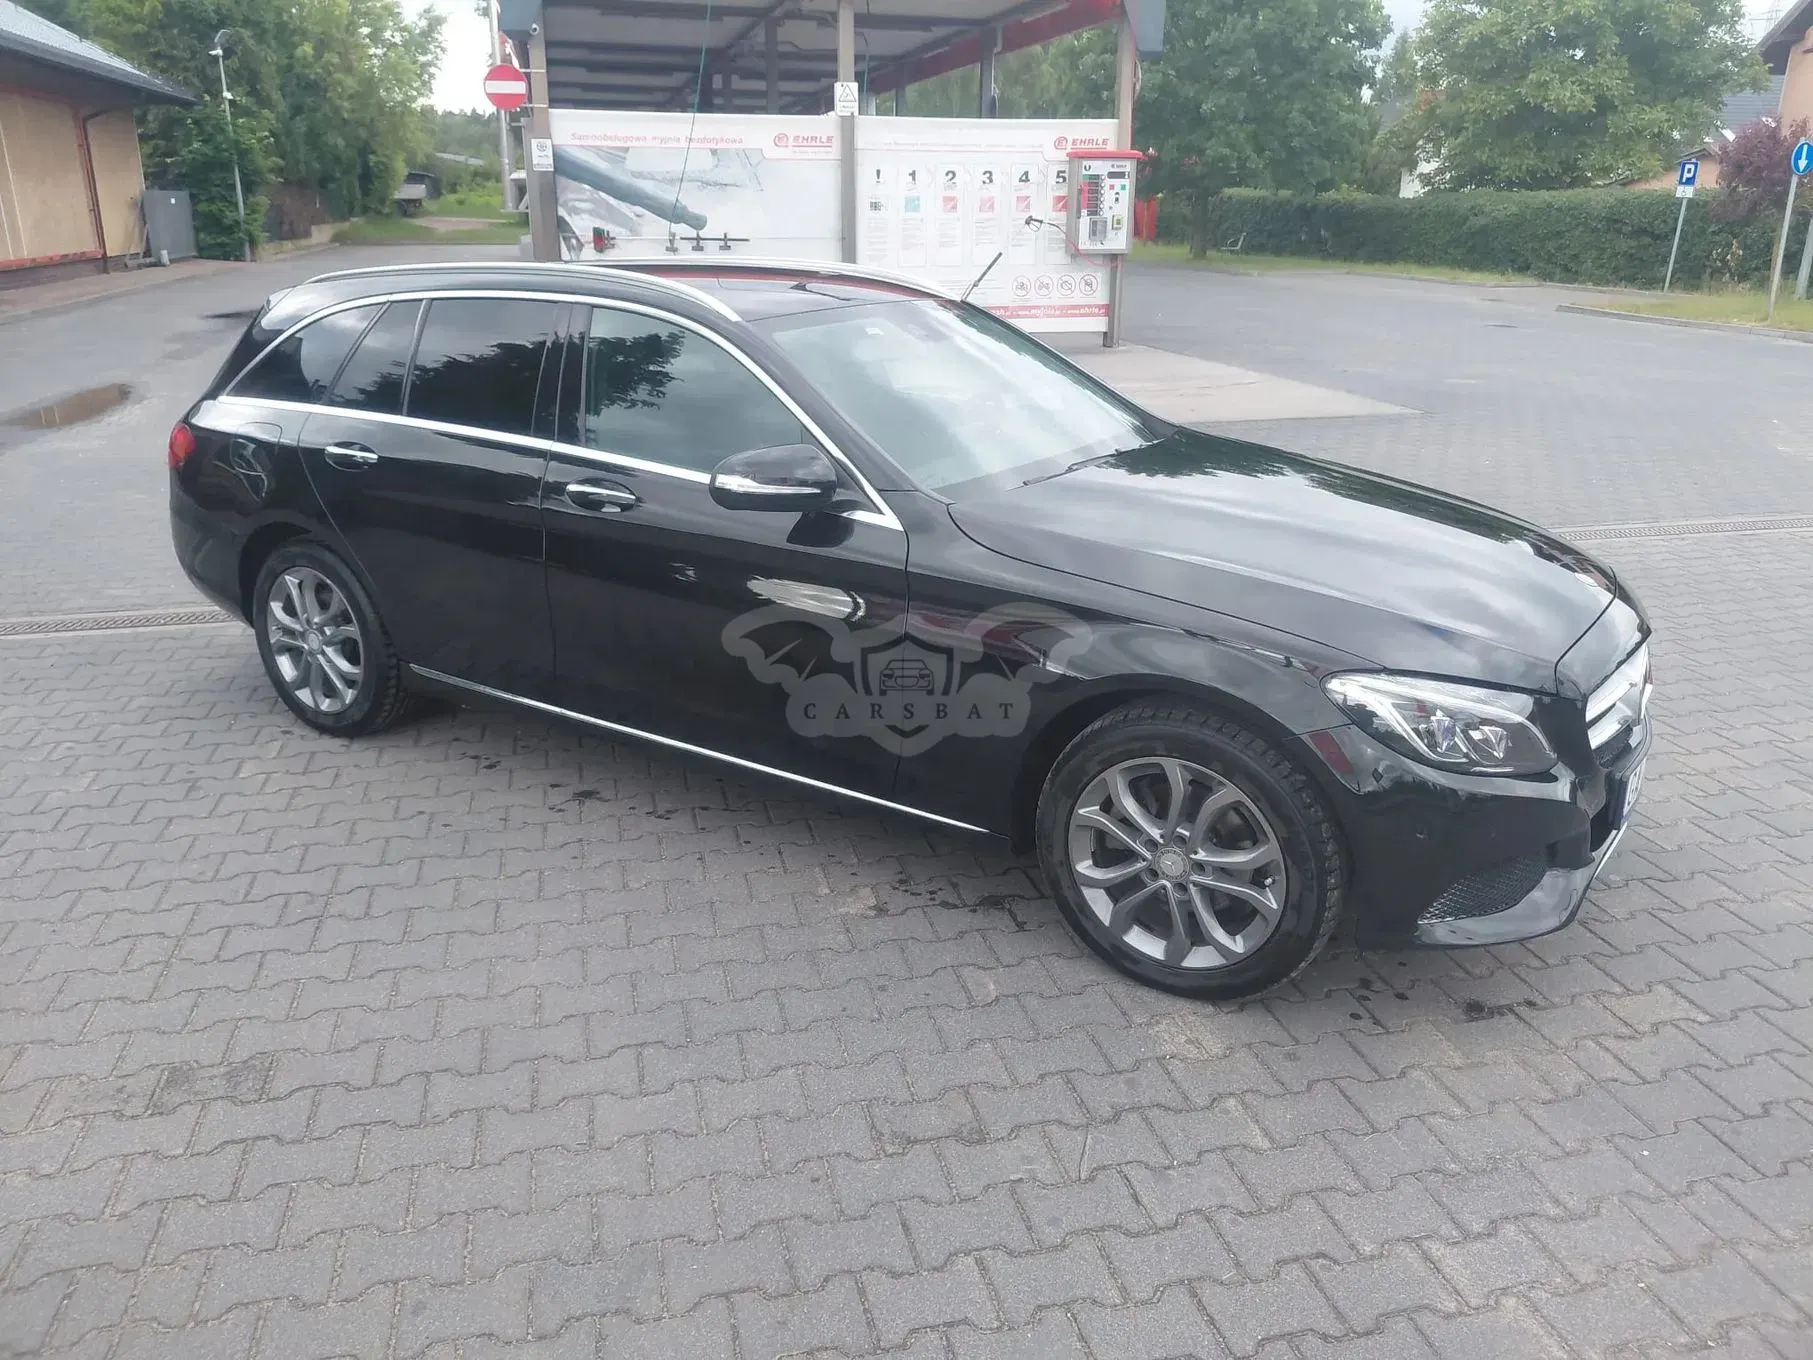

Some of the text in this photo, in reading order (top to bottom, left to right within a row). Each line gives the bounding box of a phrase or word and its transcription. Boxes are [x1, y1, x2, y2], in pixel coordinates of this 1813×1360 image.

[792, 135, 834, 144] EHRLE
[1071, 138, 1109, 146] EHRLE
[908, 169, 916, 184] 1
[945, 170, 957, 184] 2
[982, 170, 994, 185] 3
[1018, 170, 1030, 183] 4
[1055, 169, 1067, 184] 5
[1682, 164, 1695, 183] P
